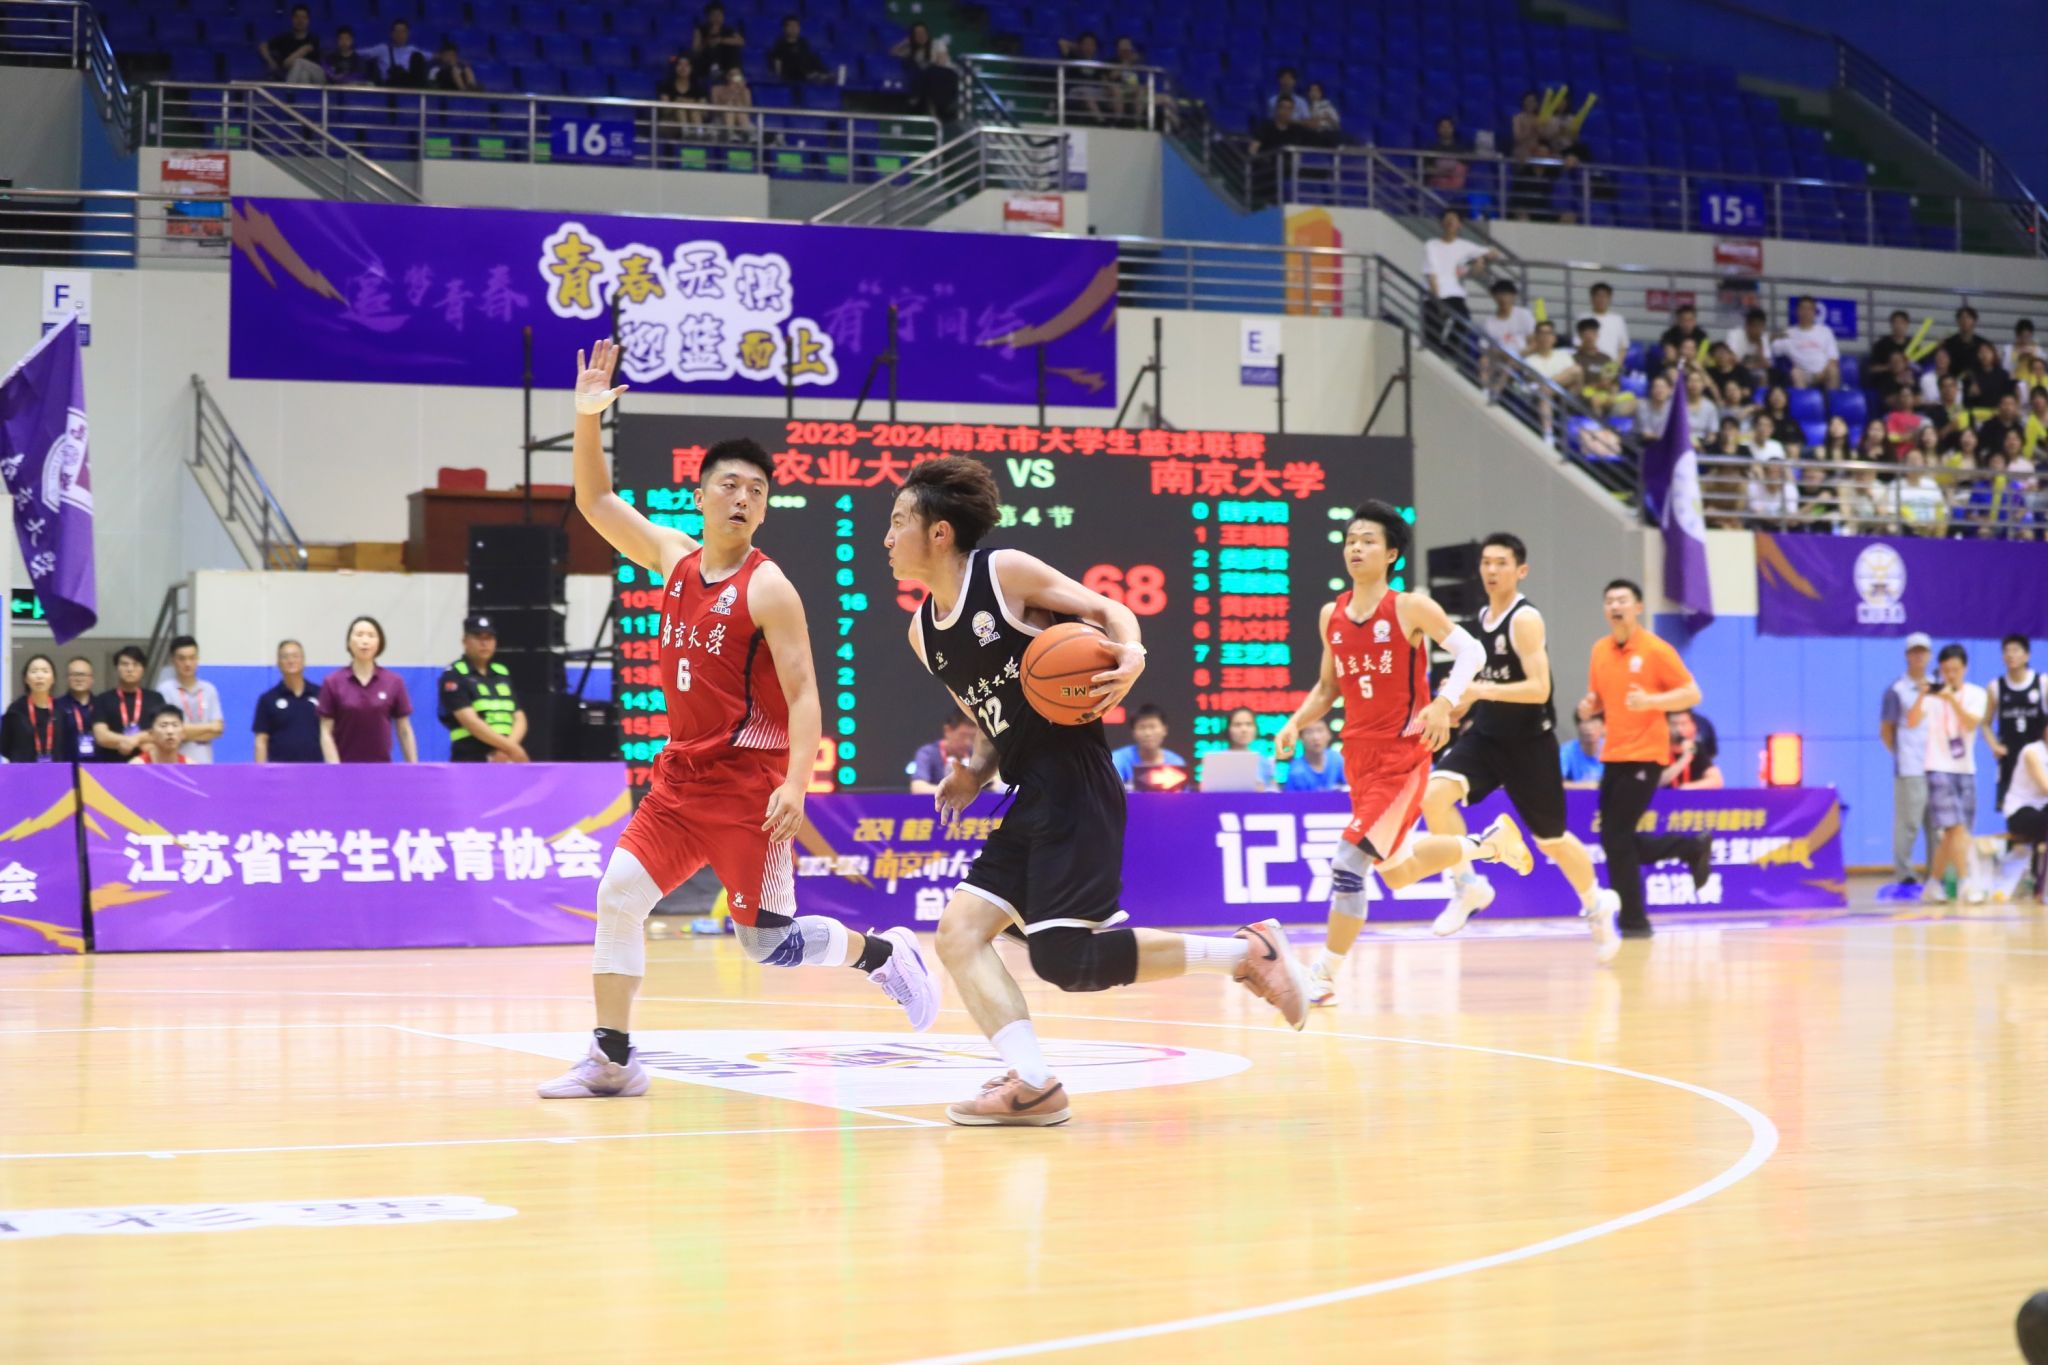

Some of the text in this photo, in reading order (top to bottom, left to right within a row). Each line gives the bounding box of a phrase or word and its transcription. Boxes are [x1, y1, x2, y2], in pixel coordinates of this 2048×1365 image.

[562, 122, 607, 156] 16
[1709, 196, 1744, 226] 15
[548, 231, 785, 312] 青春无惧
[55, 284, 70, 308] F
[620, 313, 830, 377] 迎篮而上
[1248, 330, 1262, 353] E
[672, 446, 950, 488] 南农业大
[1006, 458, 1056, 488] VS
[1149, 460, 1326, 499] 南京大学
[836, 495, 852, 512] 4
[836, 519, 853, 536] 2
[1195, 526, 1207, 543] 1
[836, 544, 854, 561] 0
[1193, 550, 1209, 567] 2
[1082, 564, 1168, 616] 68
[1194, 573, 1210, 591] 3
[838, 618, 854, 635] 7
[837, 643, 854, 660] 4
[1194, 645, 1210, 662] 7
[676, 657, 692, 692] 6
[838, 667, 854, 685] 2
[1358, 674, 1374, 699] 5
[978, 695, 1011, 739] 12
[125, 827, 603, 886] 江苏省学生体育协会
[0, 861, 39, 904] 会
